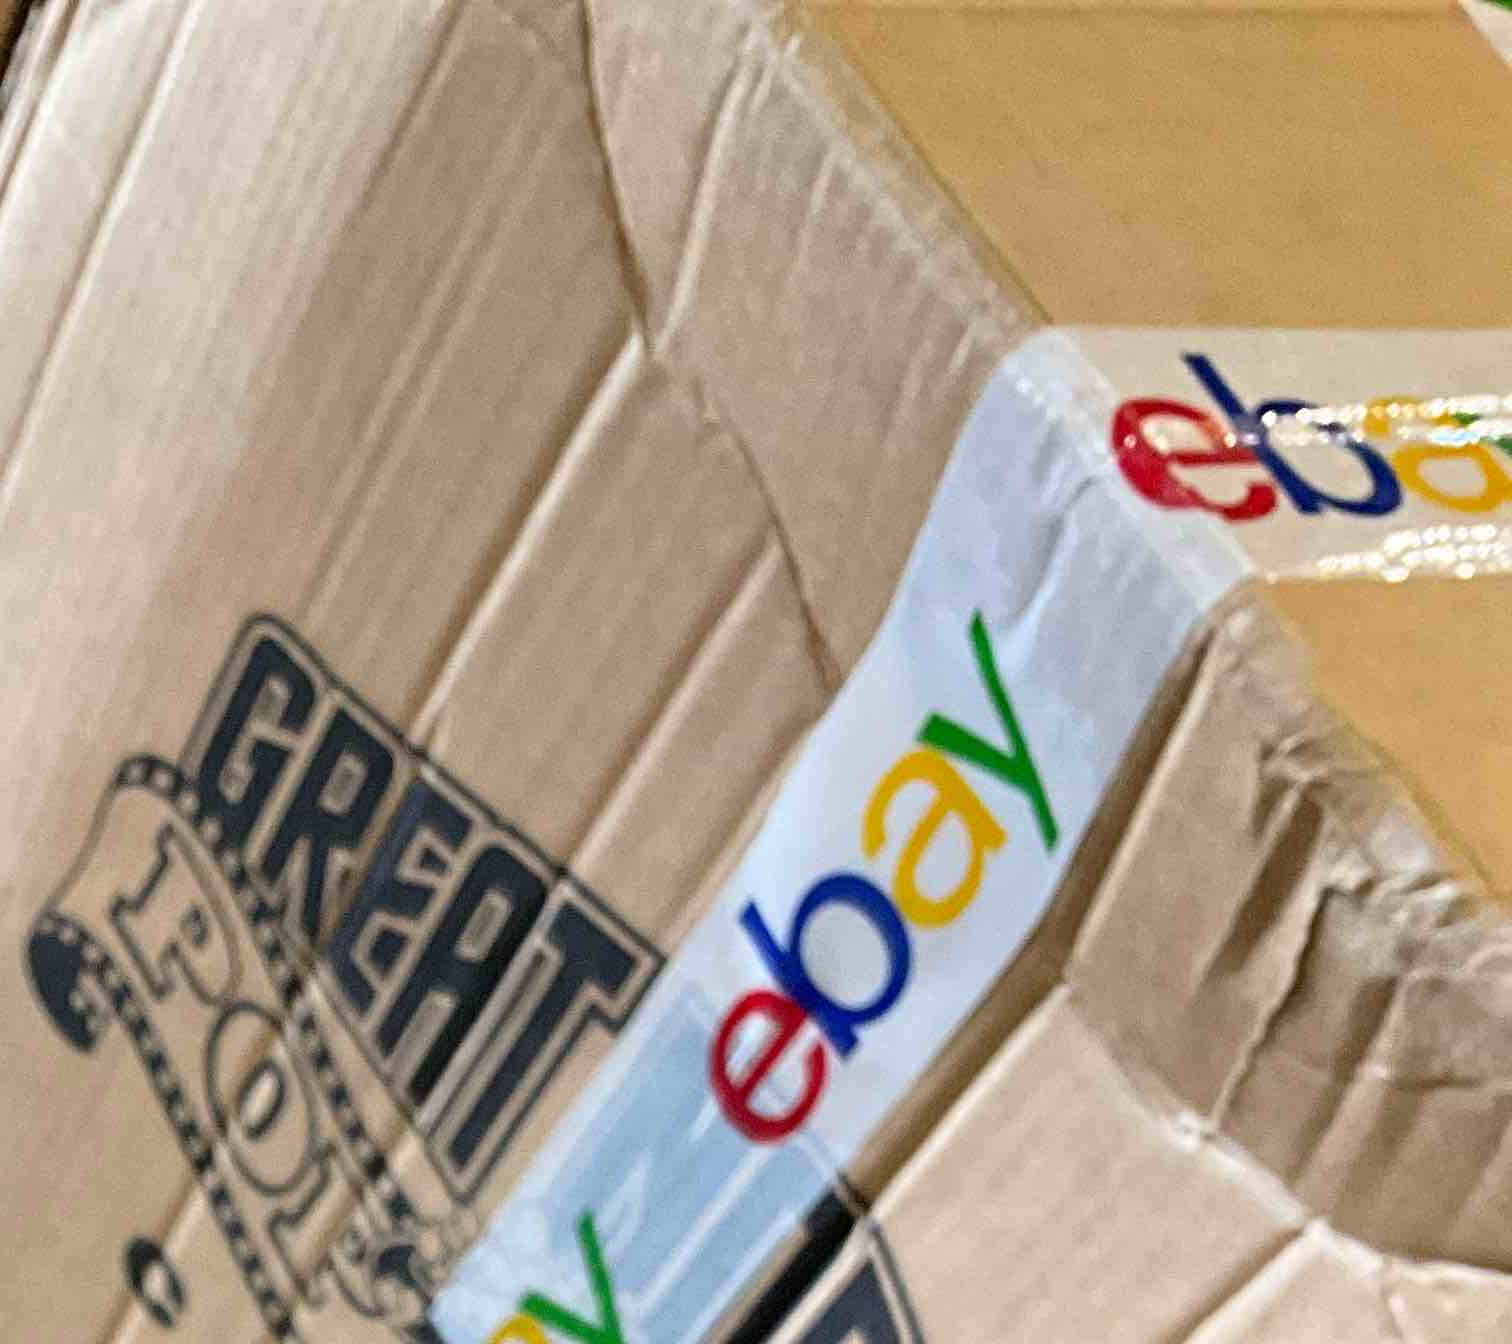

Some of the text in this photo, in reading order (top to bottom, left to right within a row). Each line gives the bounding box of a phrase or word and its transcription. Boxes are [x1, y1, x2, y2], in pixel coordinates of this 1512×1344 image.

[1110, 350, 1512, 525] eba
[186, 632, 653, 1185] GREAT
[705, 609, 1064, 1144] ebay
